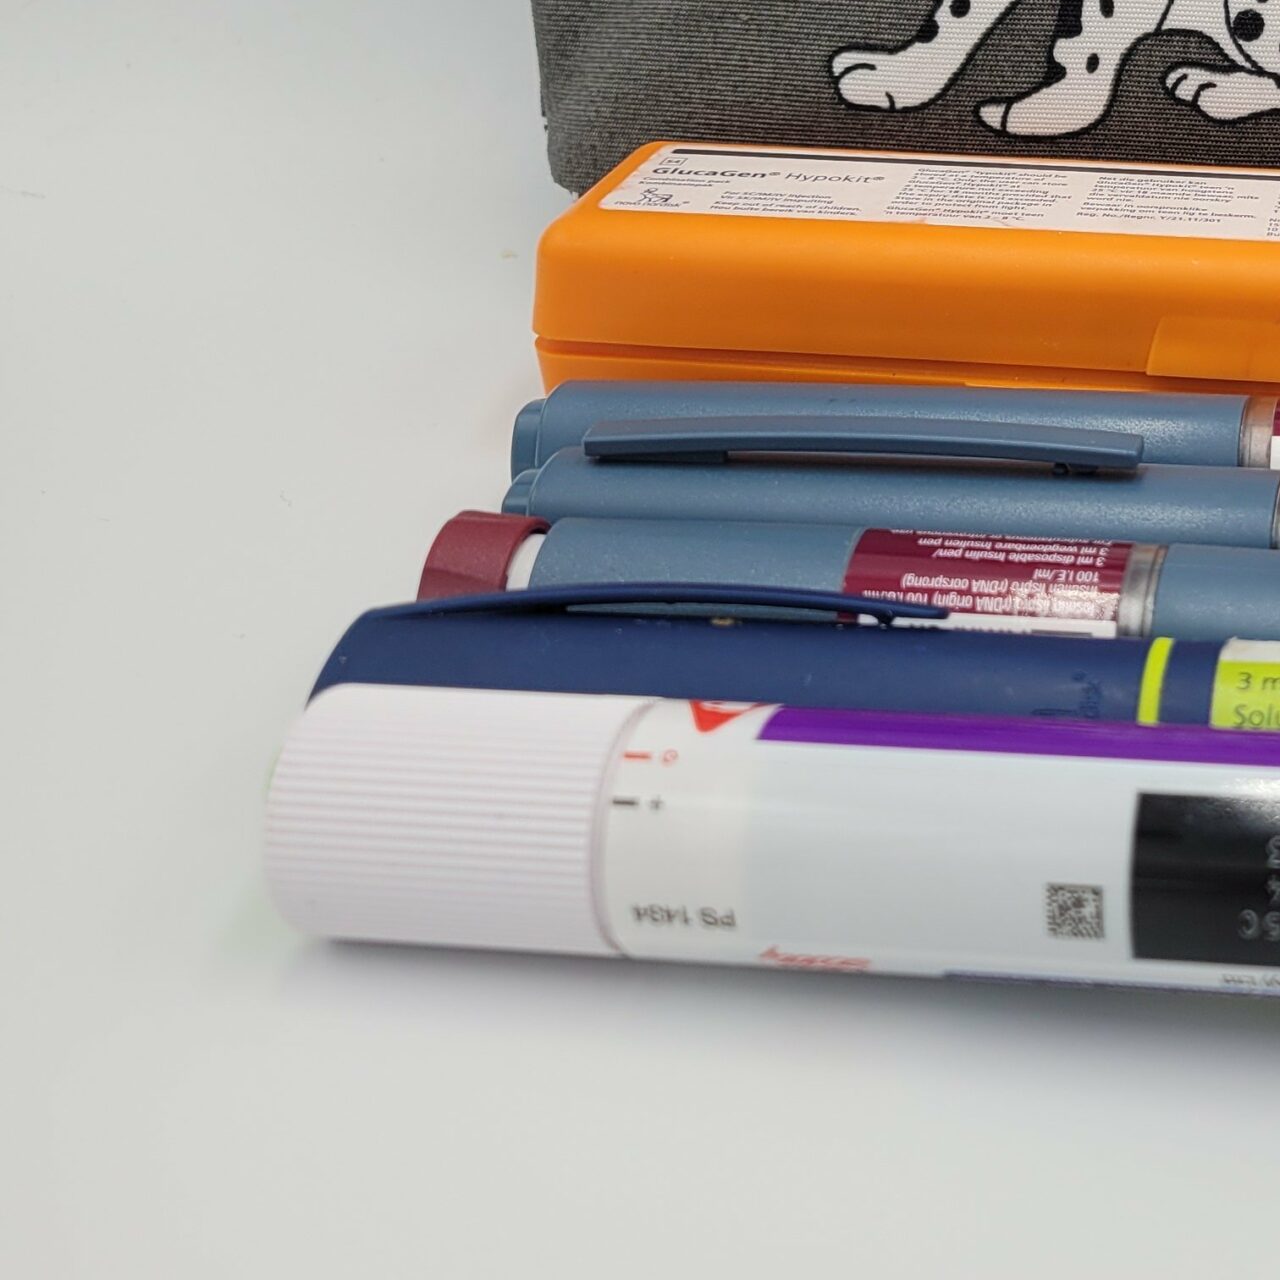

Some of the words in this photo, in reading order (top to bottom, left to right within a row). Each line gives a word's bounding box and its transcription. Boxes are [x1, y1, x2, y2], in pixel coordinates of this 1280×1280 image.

[918, 537, 941, 546] pen
[944, 539, 992, 549] Insulien
[932, 548, 962, 558] pen/
[995, 542, 1077, 553] wegdoenbare
[1081, 546, 1096, 554] ml
[965, 550, 1005, 560] Insulin
[1009, 552, 1074, 563] disposable
[1077, 556, 1093, 565] ml
[1096, 557, 1106, 566] 3
[1033, 568, 1074, 580] I.E./ml
[1077, 571, 1099, 582] 100
[901, 574, 969, 589] oorsprong)
[972, 579, 1008, 592] (rDNA
[1011, 579, 1046, 594] lispro
[907, 593, 928, 606] 100
[931, 591, 973, 608] origin)
[975, 595, 1012, 610] (rDNA
[1236, 672, 1250, 691] 3
